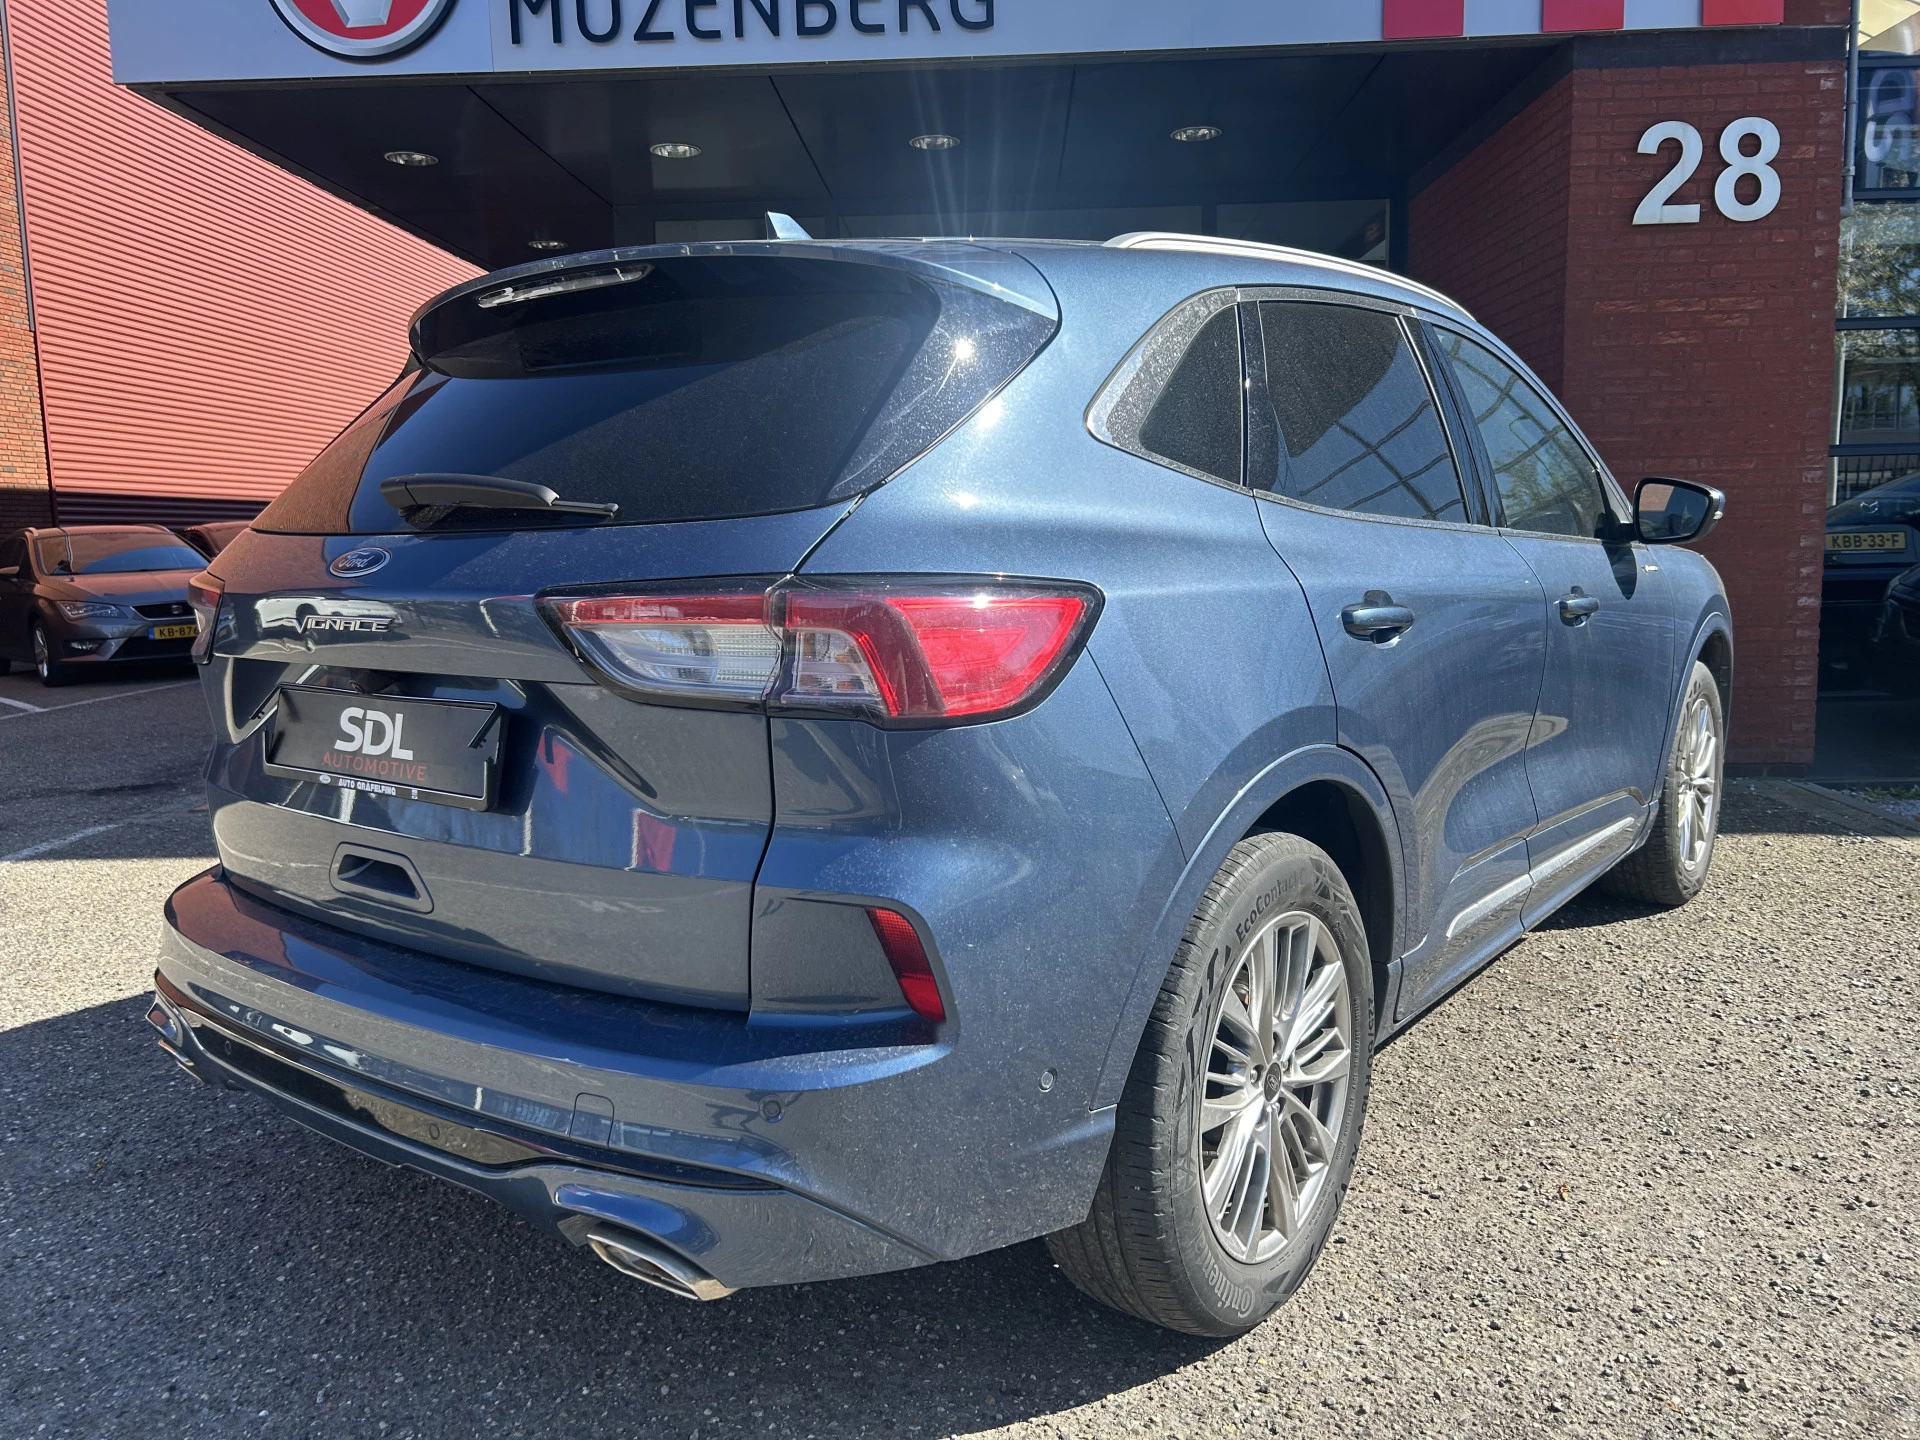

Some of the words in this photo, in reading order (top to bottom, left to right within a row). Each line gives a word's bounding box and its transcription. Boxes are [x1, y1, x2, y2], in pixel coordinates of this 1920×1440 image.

[1632, 116, 1782, 225] 28
[1831, 534, 1900, 549] KBB-33-F
[334, 706, 414, 761] SDL
[321, 751, 427, 782] AUTOMOTIVE
[338, 778, 355, 789] AUTO
